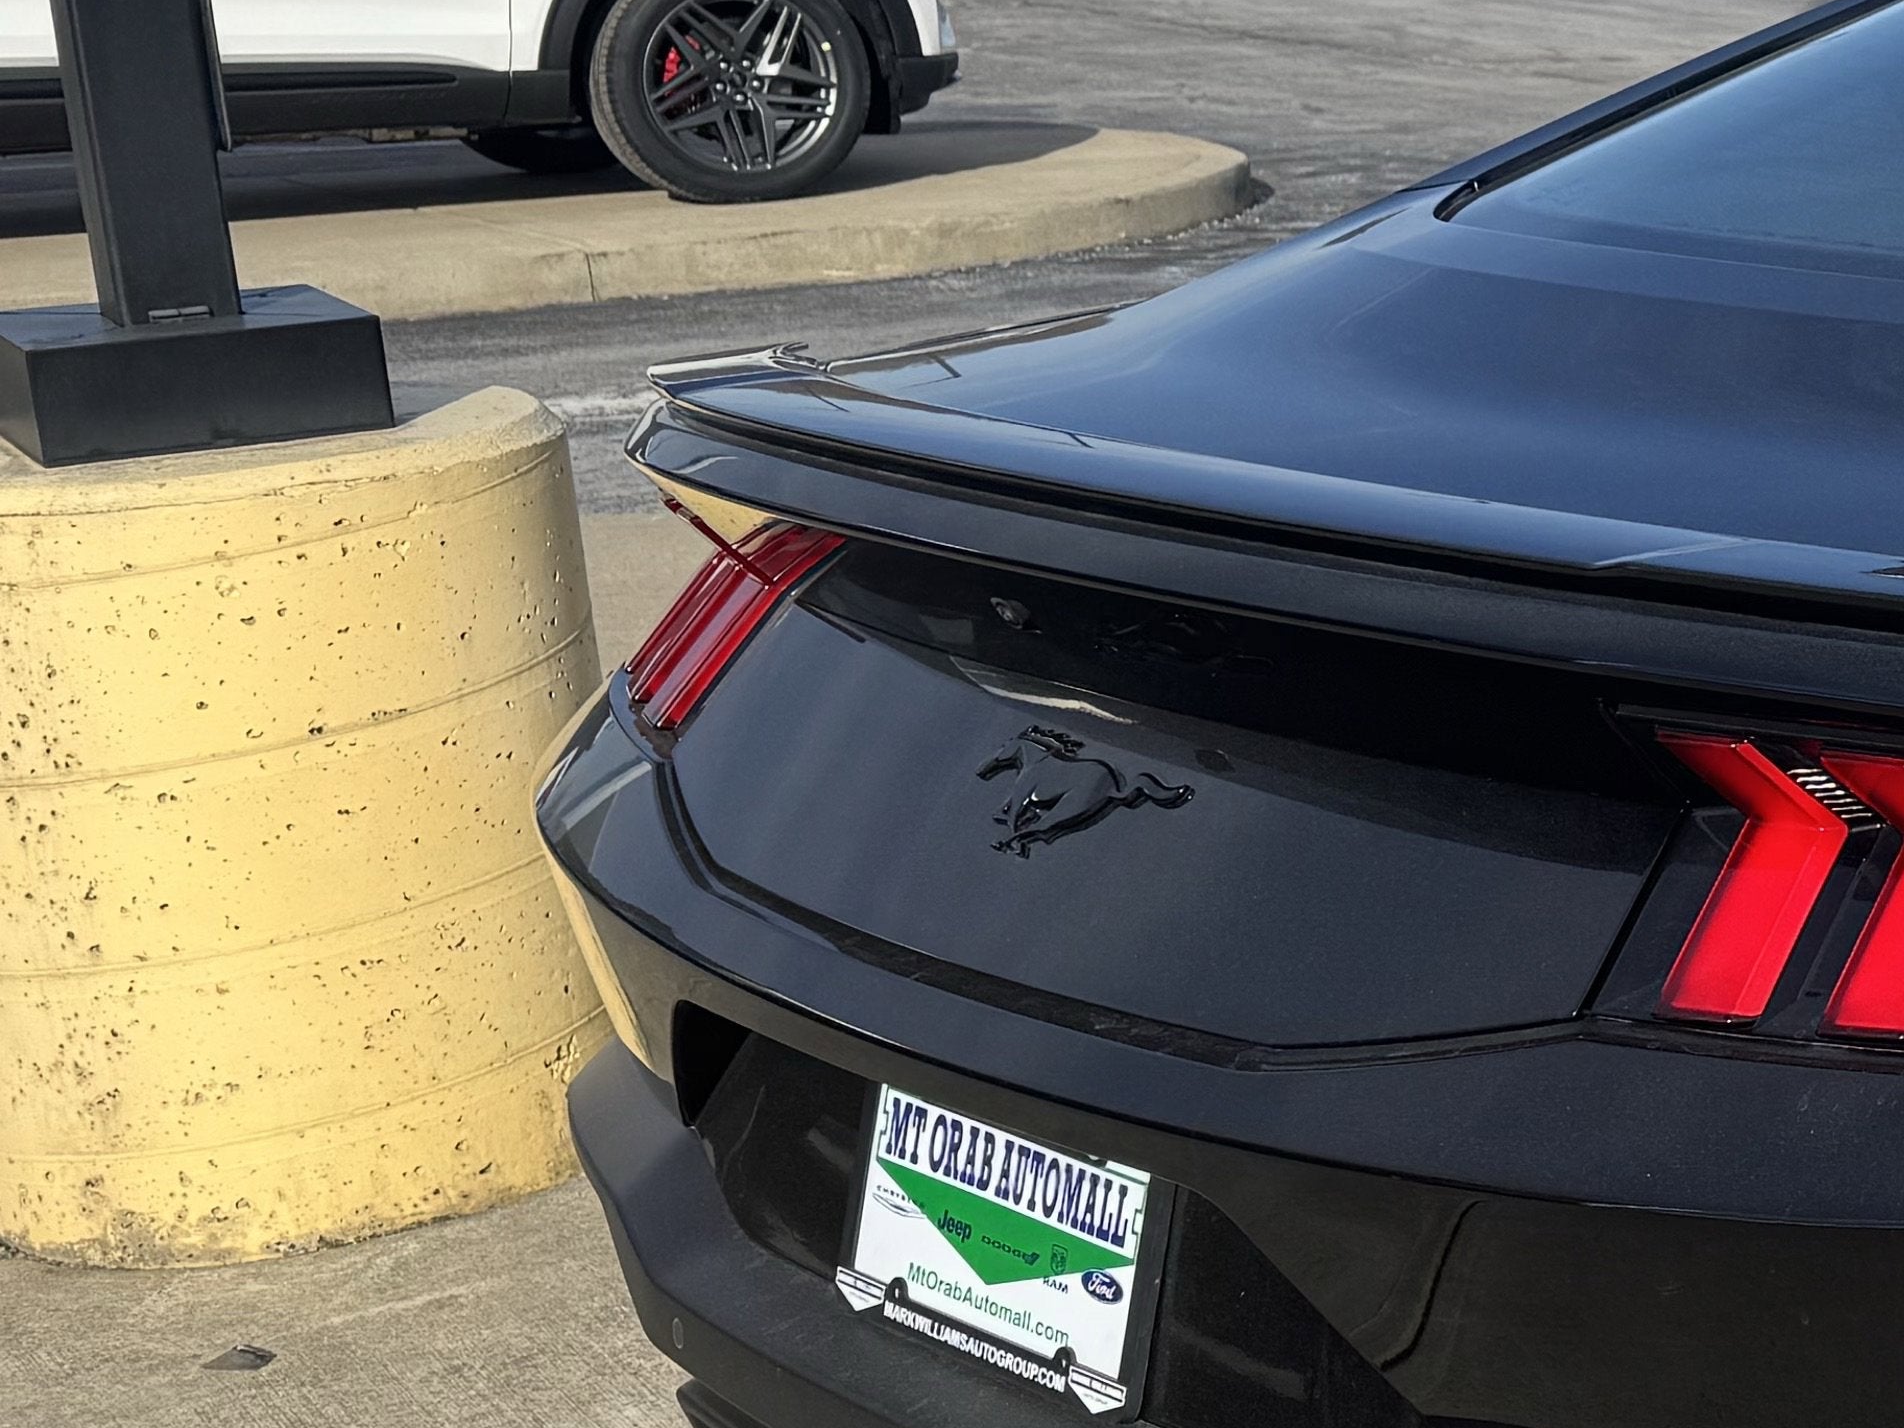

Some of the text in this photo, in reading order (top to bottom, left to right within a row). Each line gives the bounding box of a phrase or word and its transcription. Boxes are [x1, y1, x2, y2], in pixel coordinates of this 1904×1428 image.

[885, 1097, 1130, 1249] MT ORAB AUTOMALL
[936, 1209, 973, 1244] Jeep
[980, 1234, 1032, 1262] DODGE
[1042, 1276, 1070, 1295] RAM
[1083, 1272, 1118, 1300] Ford
[906, 1262, 1070, 1346] MtOrabAutomall.com
[883, 1300, 1066, 1393] MARKWILLIAMSAUTOGROUP.COM
